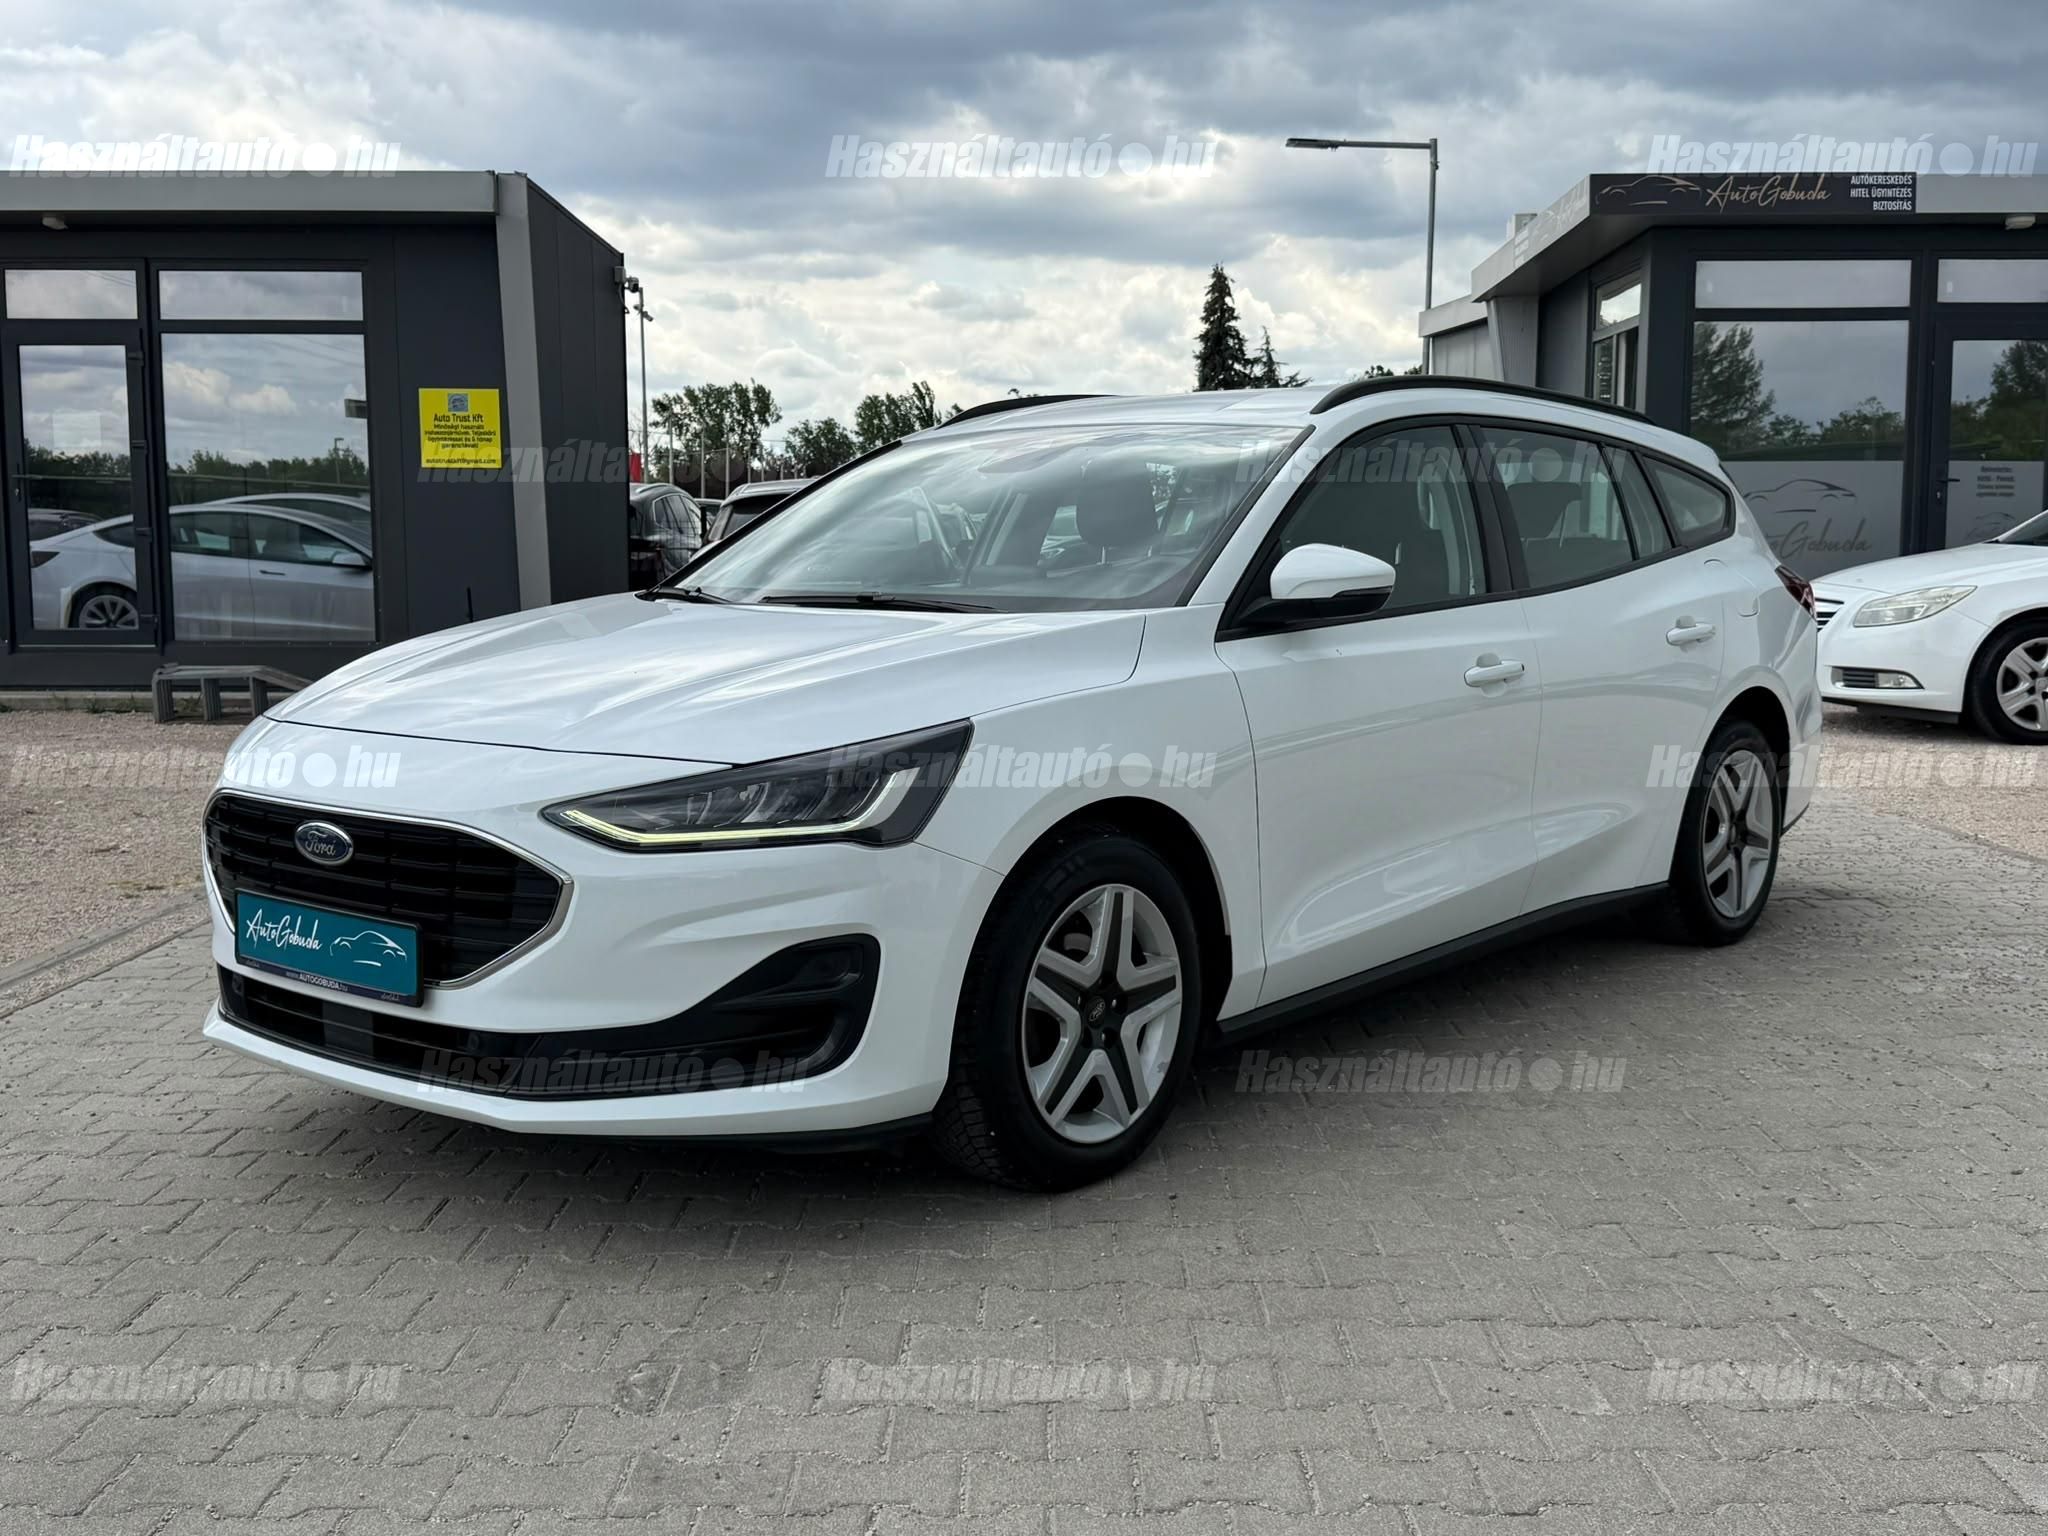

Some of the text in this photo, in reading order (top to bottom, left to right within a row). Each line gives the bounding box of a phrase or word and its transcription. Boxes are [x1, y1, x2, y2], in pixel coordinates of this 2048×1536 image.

[1850, 174, 1913, 185] AUTÓKERESKEDÉS
[1705, 173, 1831, 213] AutoGobuda
[1850, 186, 1913, 198] HITEL ÜGYINTÉZÉS
[1872, 199, 1913, 211] BIZTOSÍTÁS
[433, 413, 484, 423] Auto Trust Kft
[304, 829, 337, 857] Ford
[246, 908, 323, 951] AutoGobuda
